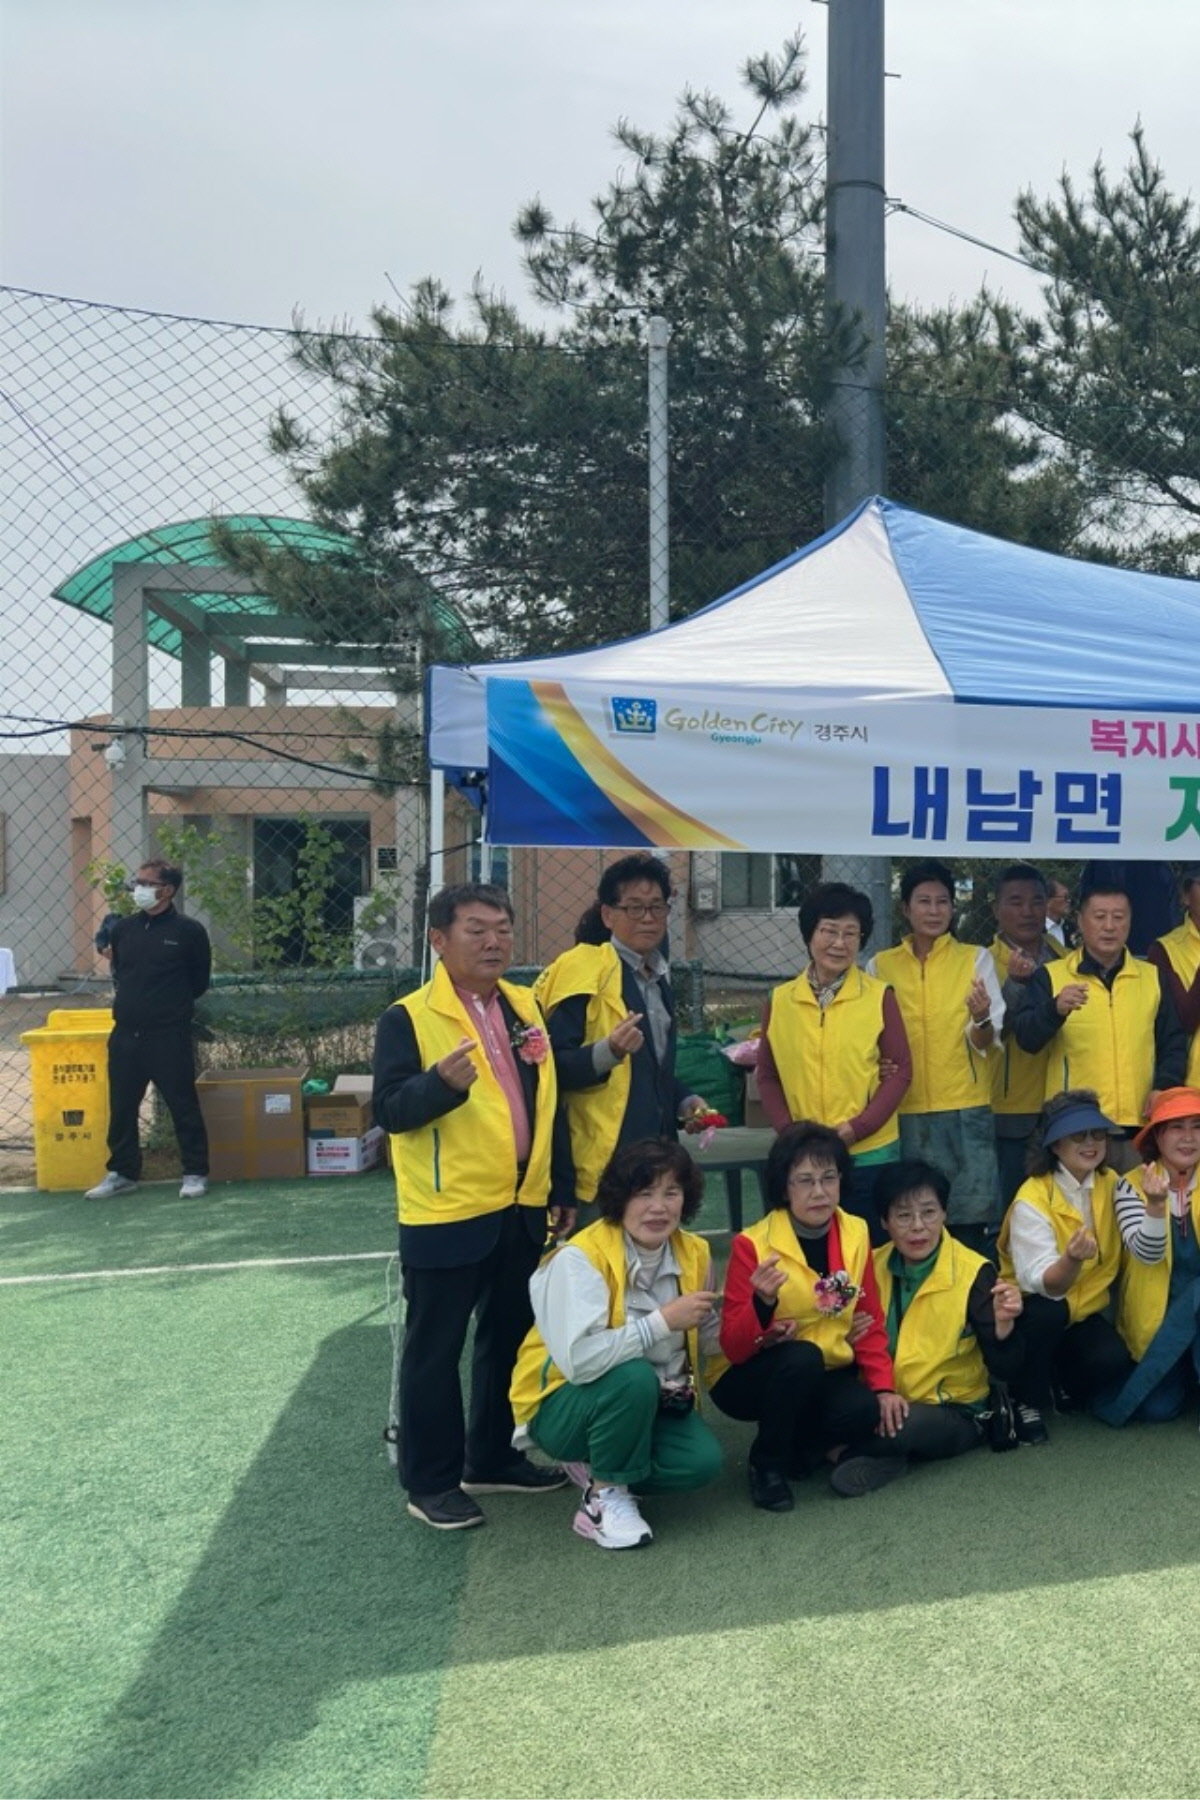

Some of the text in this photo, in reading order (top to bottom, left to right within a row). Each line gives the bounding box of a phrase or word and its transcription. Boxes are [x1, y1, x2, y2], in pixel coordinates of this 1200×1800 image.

[664, 707, 804, 741] Golden City
[814, 723, 869, 743] 경주시
[711, 732, 762, 746] Gyeongju
[871, 766, 1122, 845] 내남면
